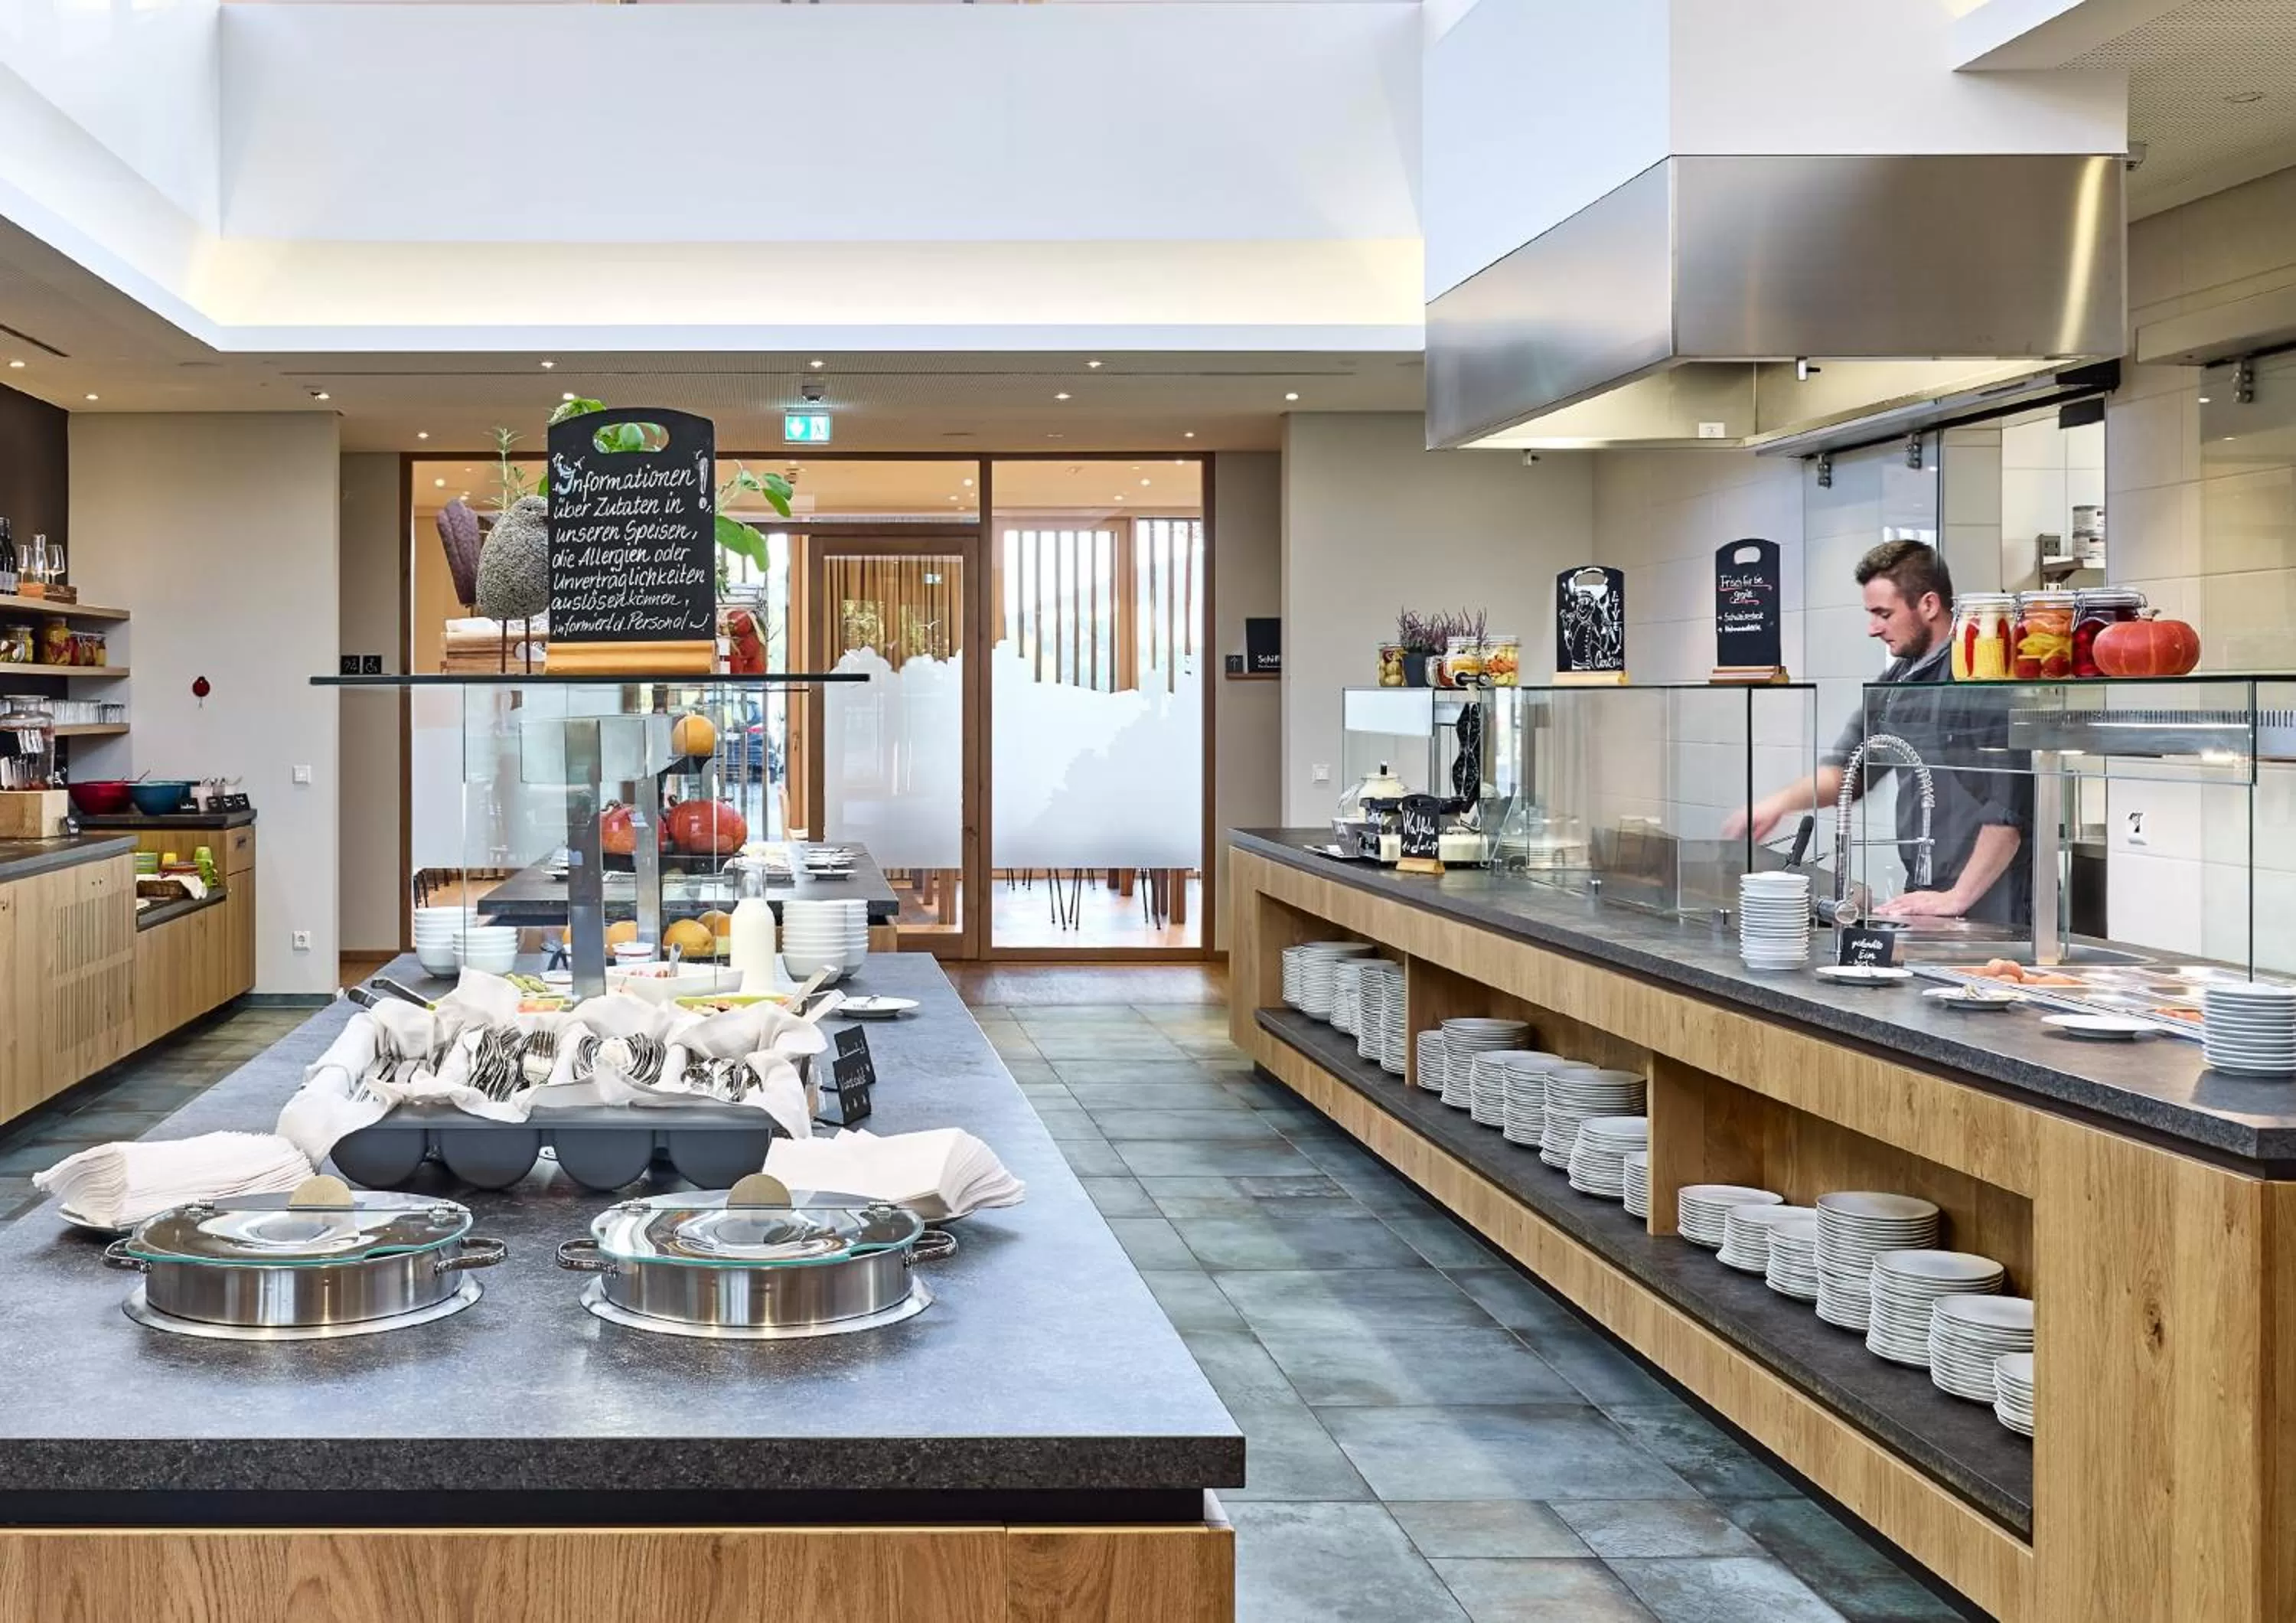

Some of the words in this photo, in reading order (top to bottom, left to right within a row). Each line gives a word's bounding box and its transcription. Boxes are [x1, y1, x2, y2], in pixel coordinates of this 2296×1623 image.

[553, 498, 591, 519] über
[593, 496, 660, 517] Zutaten
[664, 491, 685, 514] in
[556, 524, 621, 543] unseren
[552, 549, 575, 568] die
[578, 542, 651, 571] Allergien
[654, 543, 690, 563] oder
[551, 589, 627, 610] auslösen
[627, 609, 689, 631] Personal
